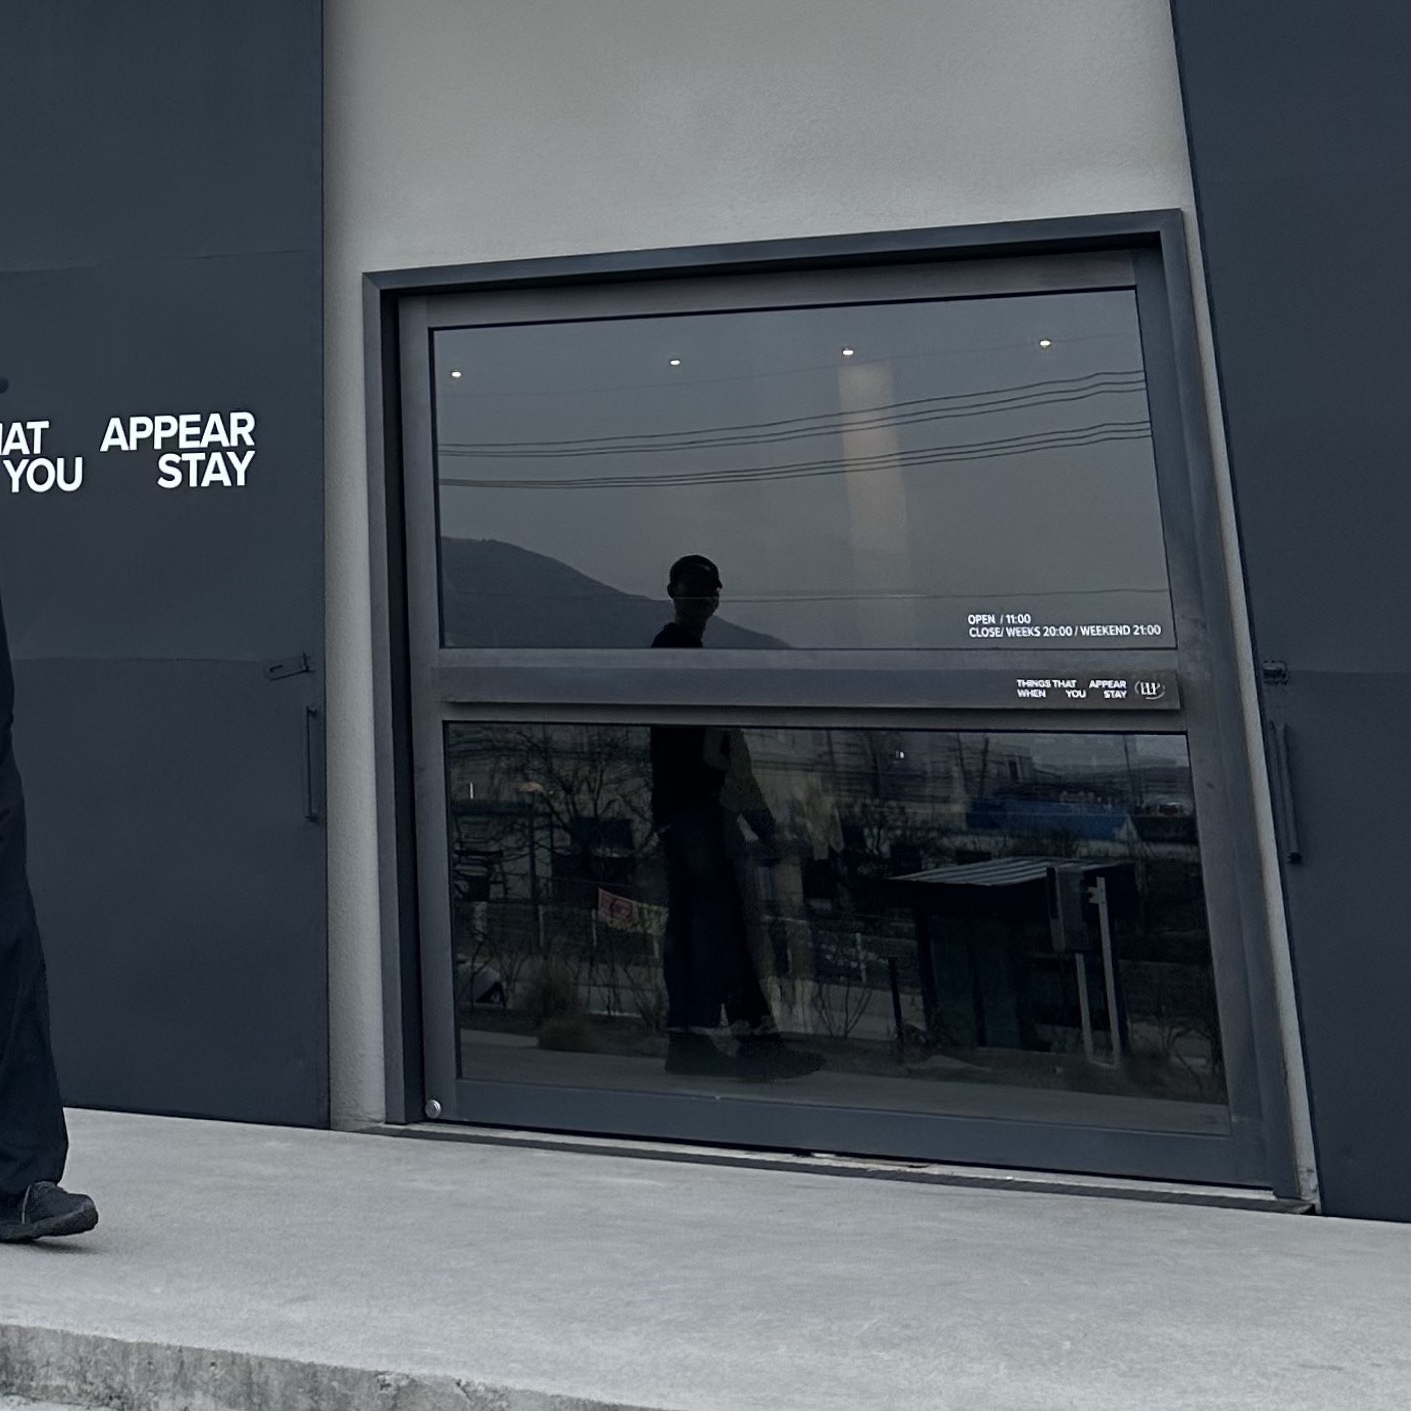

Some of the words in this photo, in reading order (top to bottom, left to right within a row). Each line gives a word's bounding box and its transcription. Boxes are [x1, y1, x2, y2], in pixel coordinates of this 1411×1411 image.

[100, 411, 255, 452] APPEAR
[3, 456, 83, 493] YOU
[157, 451, 255, 488] STAY
[968, 614, 996, 624] OPEN
[1006, 613, 1031, 624] 11:00
[1006, 626, 1040, 637] WEEKS
[1043, 625, 1073, 637] 20:00
[1080, 625, 1130, 636] WEEKEND
[1133, 624, 1161, 636] 21:00
[1017, 679, 1051, 688] THINGS
[1052, 679, 1077, 688] THAT
[1089, 679, 1126, 688] APPEAR
[1017, 689, 1046, 698] WHEN
[1065, 689, 1086, 698] YOU
[1103, 690, 1127, 698] STAY
